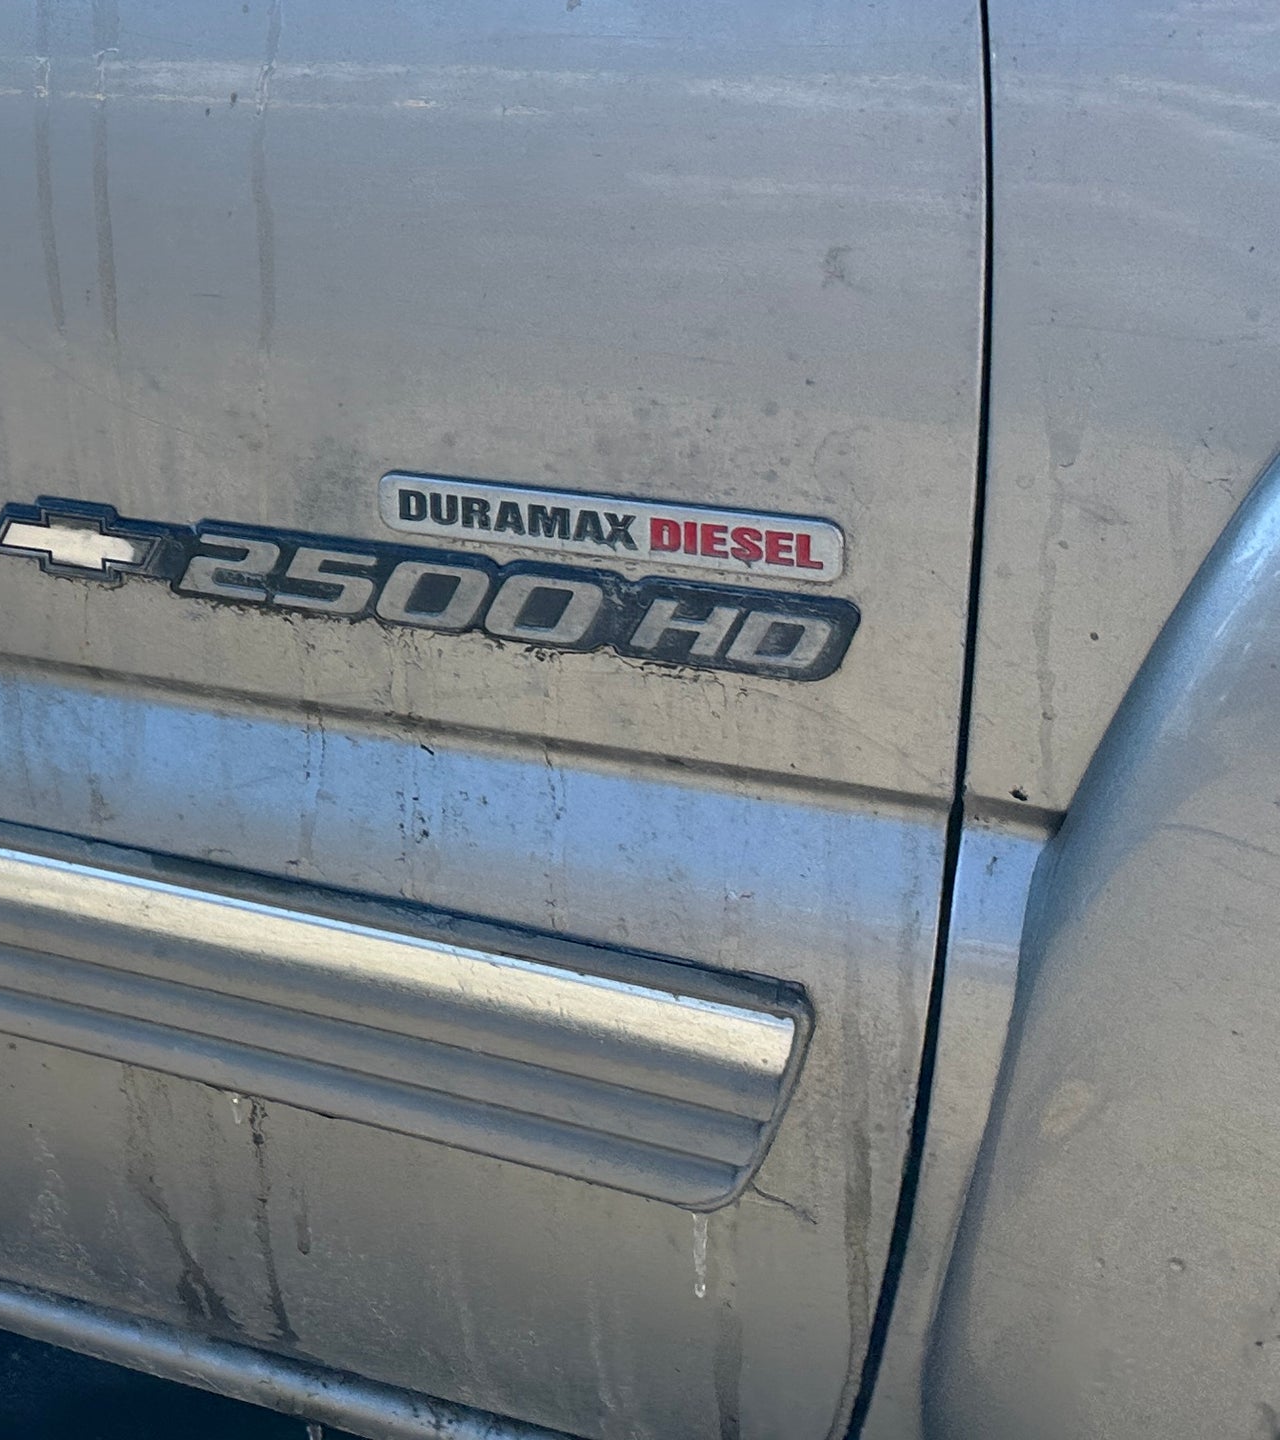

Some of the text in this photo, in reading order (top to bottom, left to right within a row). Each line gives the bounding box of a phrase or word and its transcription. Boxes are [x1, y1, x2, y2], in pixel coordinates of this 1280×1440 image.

[397, 487, 824, 570] DURAMAX DIESEL
[179, 533, 833, 667] 2500 HD
